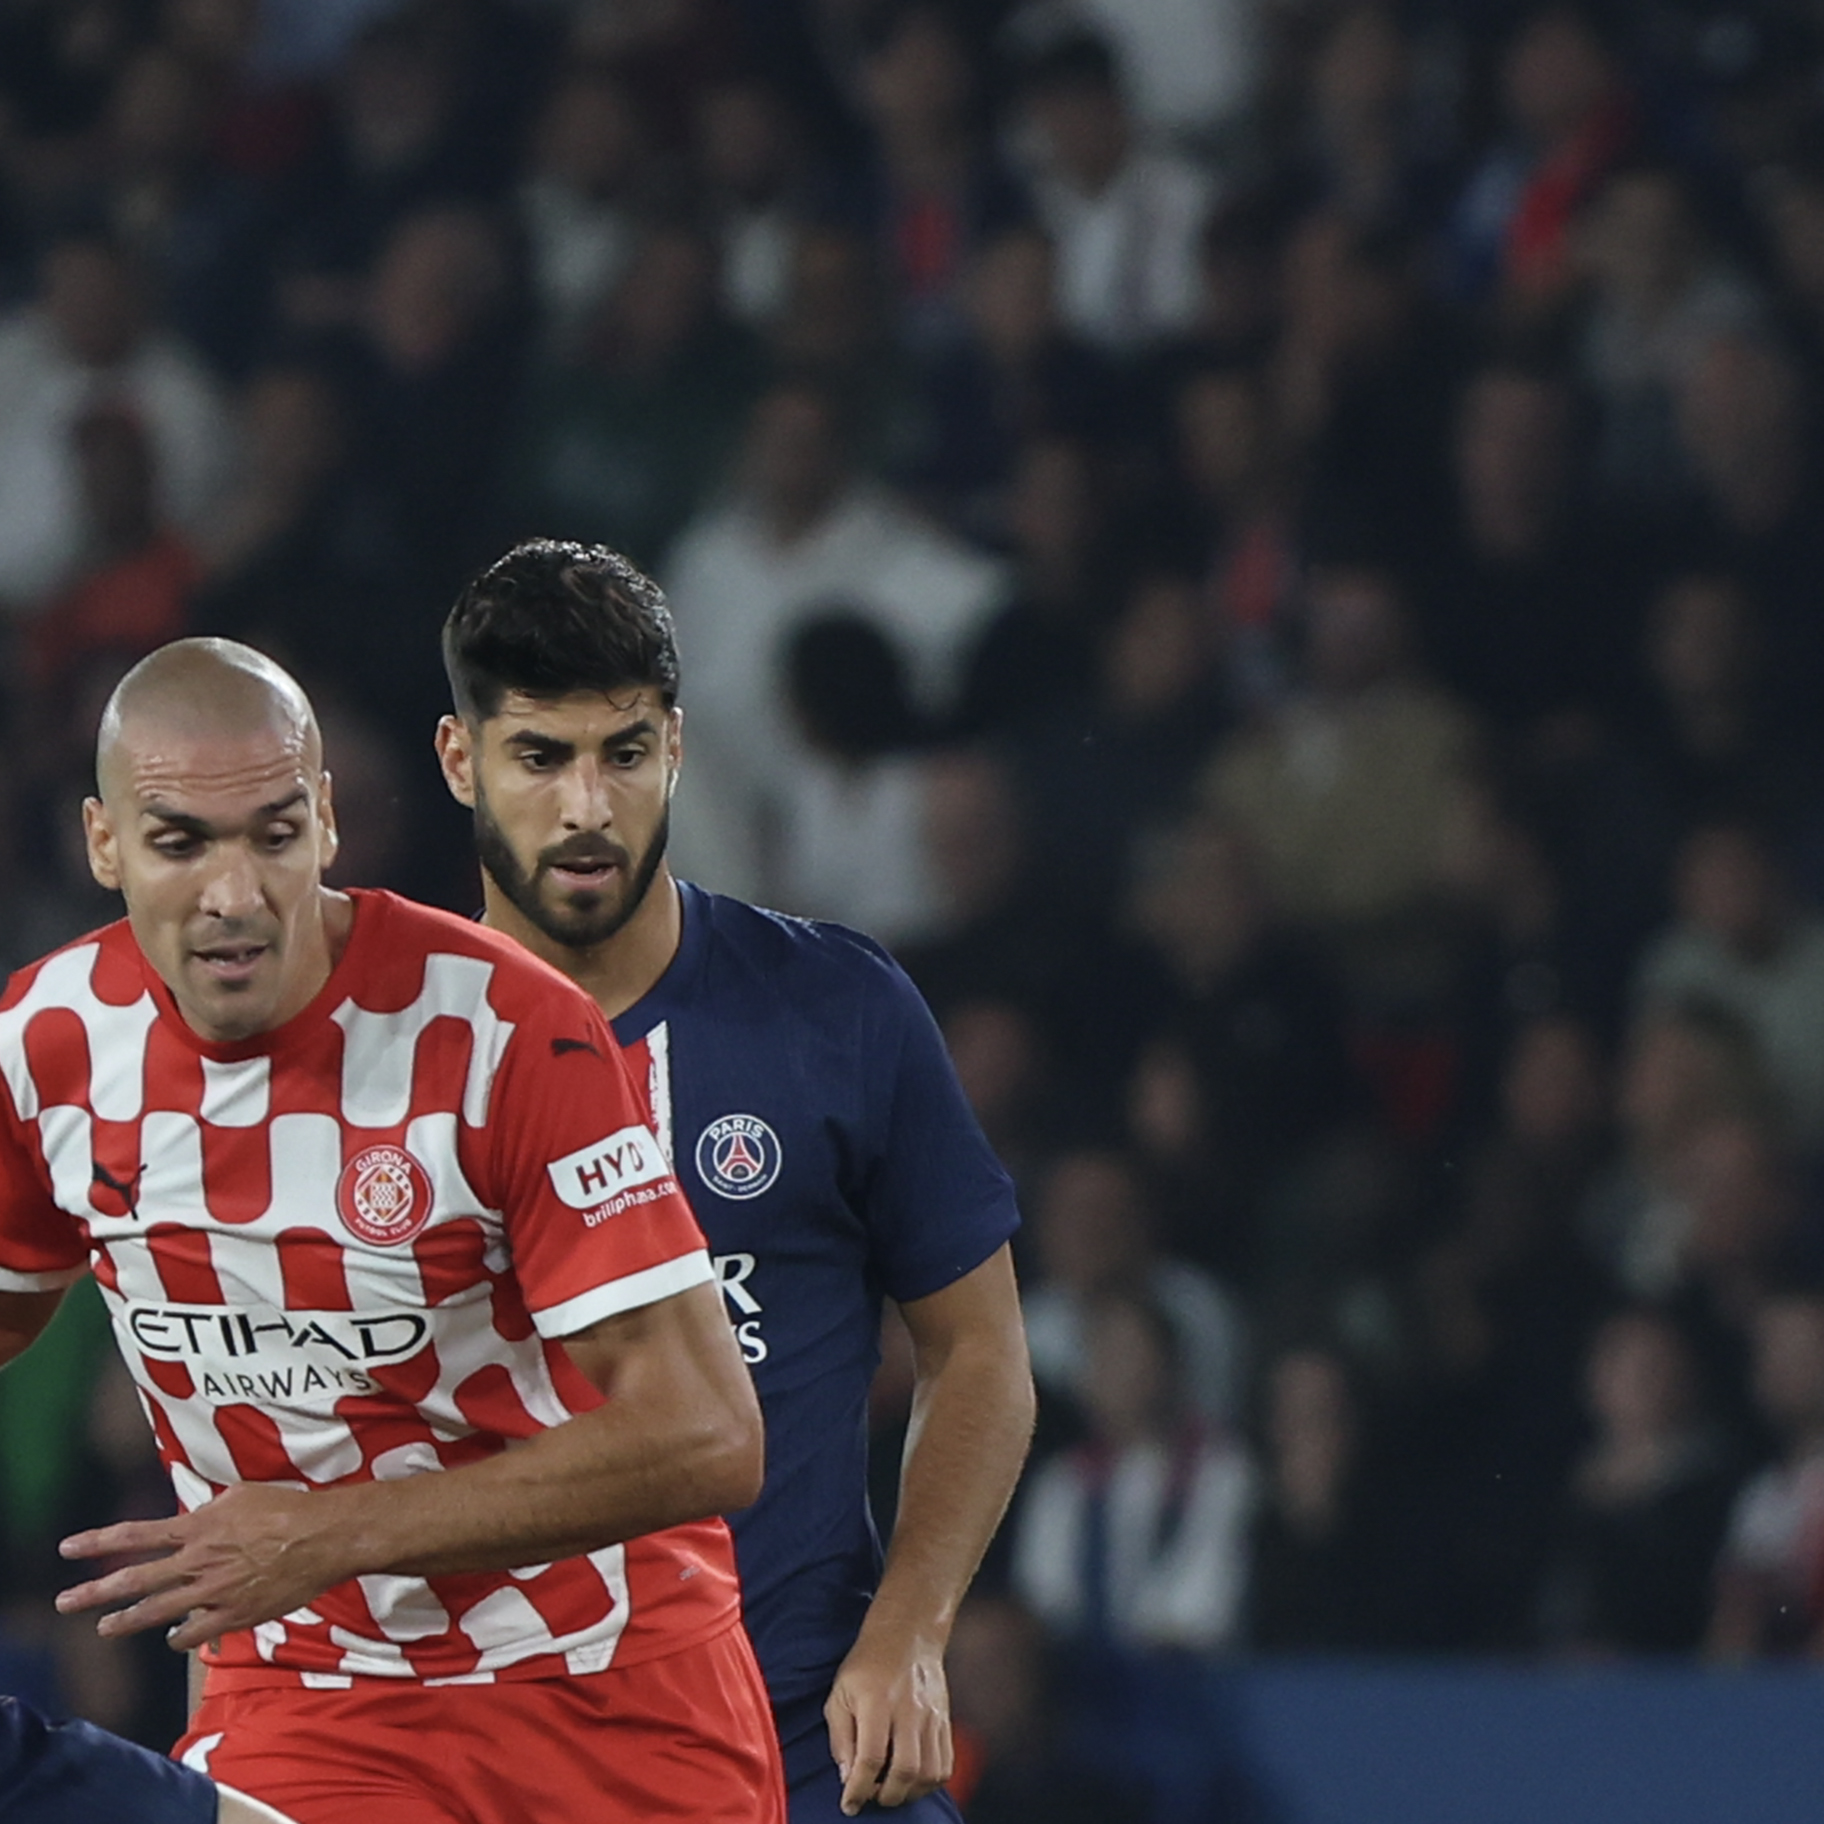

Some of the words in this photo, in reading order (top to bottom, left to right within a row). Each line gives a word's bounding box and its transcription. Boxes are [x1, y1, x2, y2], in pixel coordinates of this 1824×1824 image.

[709, 1119, 765, 1141] PARIS
[355, 1150, 412, 1175] GIRONA
[130, 1308, 426, 1360] ETIHAD
[203, 1363, 372, 1399] AIRWAYS
